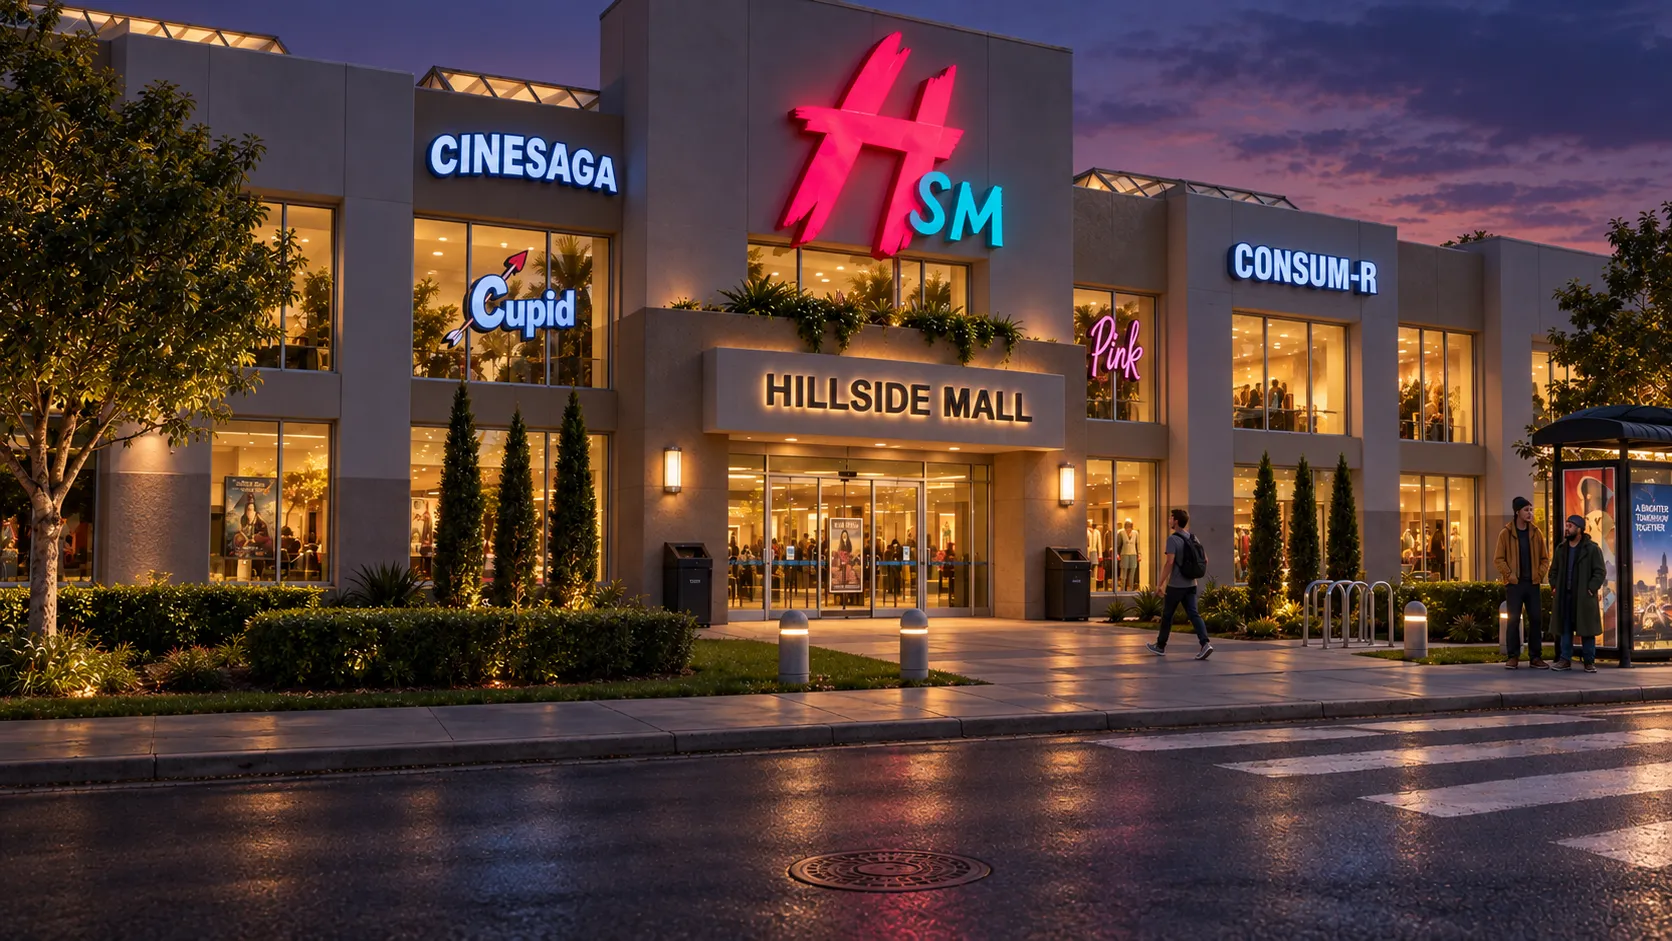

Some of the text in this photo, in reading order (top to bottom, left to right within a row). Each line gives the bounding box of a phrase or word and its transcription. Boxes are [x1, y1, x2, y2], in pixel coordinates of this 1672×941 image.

[428, 133, 618, 194] CINESAGA
[1232, 242, 1378, 295] CONSUM-R
[470, 273, 576, 340] Cupid
[1090, 315, 1144, 380] Pink
[766, 373, 1033, 422] HILLSIDE MALL
